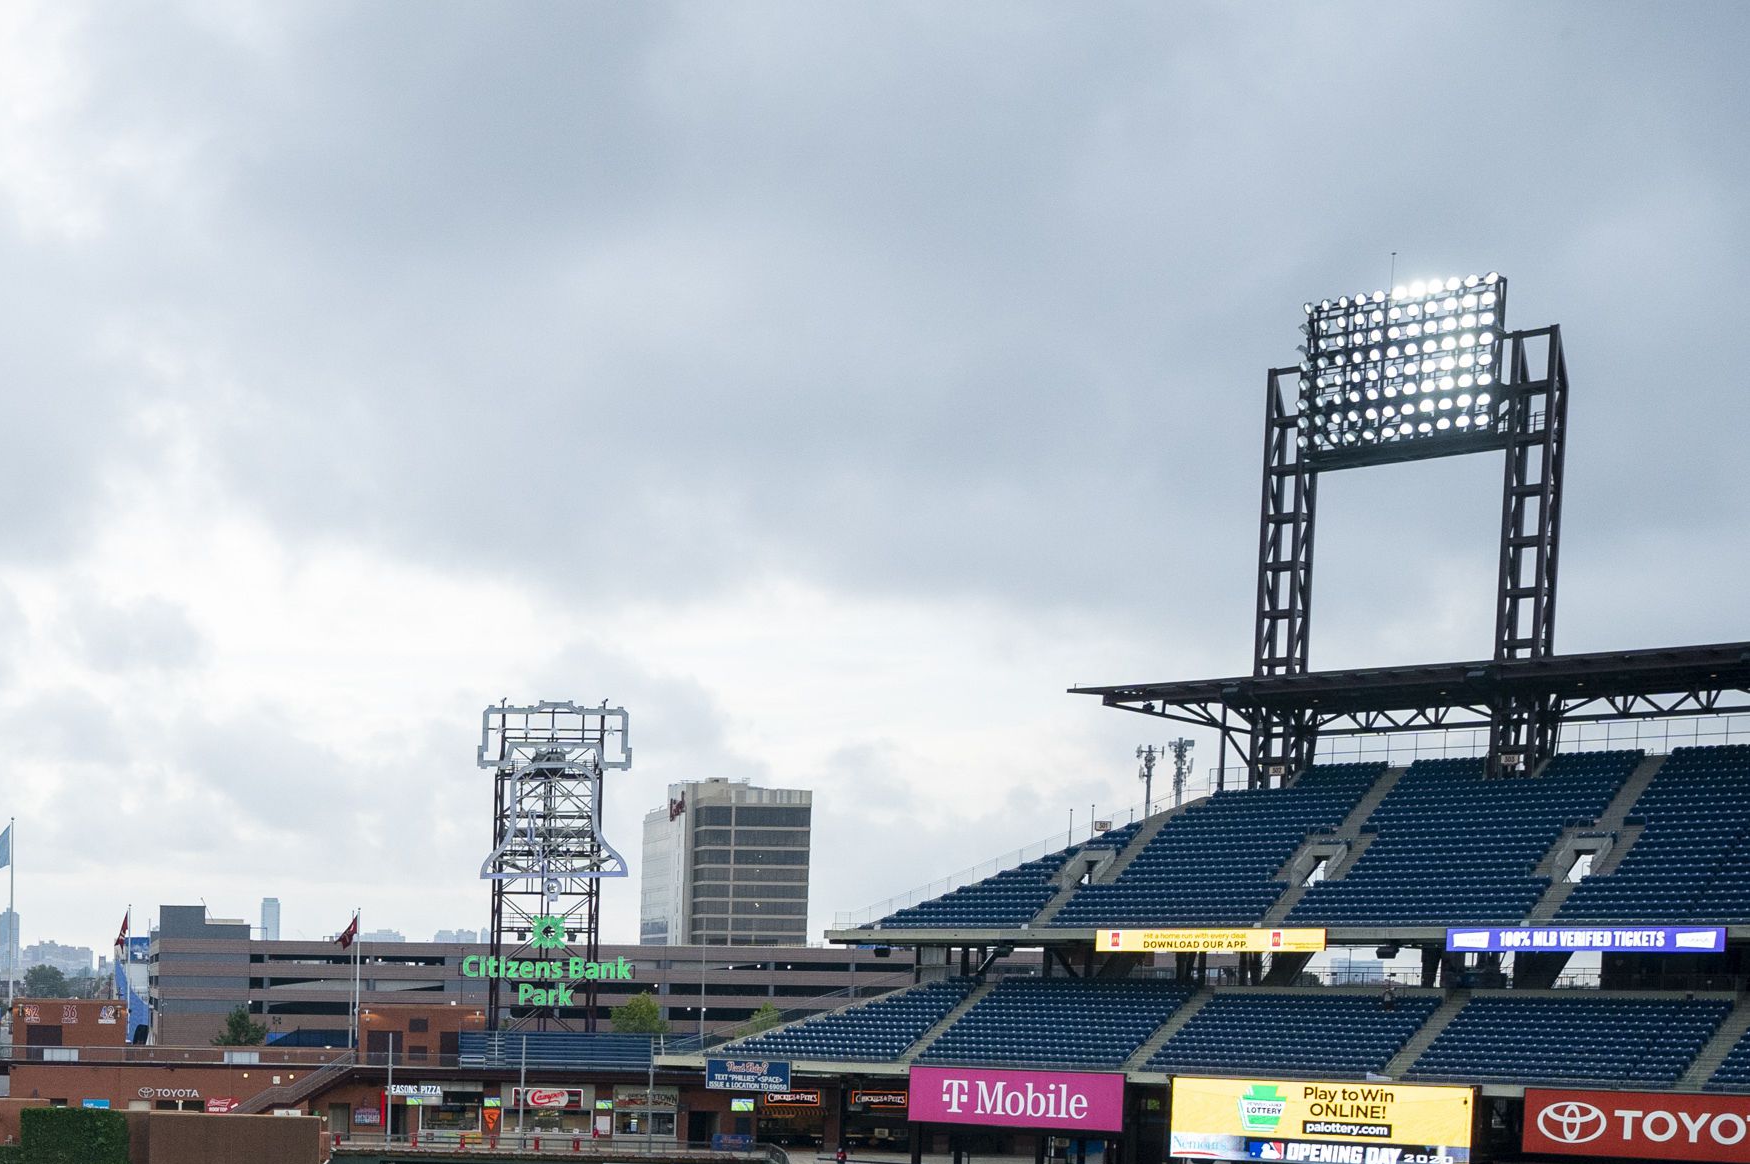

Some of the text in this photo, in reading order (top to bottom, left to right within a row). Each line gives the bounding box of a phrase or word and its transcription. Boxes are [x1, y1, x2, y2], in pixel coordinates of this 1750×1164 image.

[1143, 941, 1200, 949] DOWNLOAD
[1227, 940, 1248, 949] APP.
[1500, 931, 1531, 947] 100%
[1533, 931, 1558, 947] MLB
[1559, 931, 1611, 947] VERIFIED
[1613, 931, 1665, 946] TICKETS
[462, 954, 633, 980] Citizens Bank
[518, 982, 575, 1006] Park
[155, 1088, 200, 1098] TOYOTA
[420, 1085, 442, 1095] PIZZA
[1303, 1087, 1394, 1103] Play to Win
[1246, 1107, 1282, 1115] LOTTERY
[1310, 1103, 1386, 1119] ONLINE!
[1305, 1121, 1388, 1136] palottery.com
[1286, 1142, 1364, 1164] OPENING
[1403, 1154, 1454, 1164] 2020
